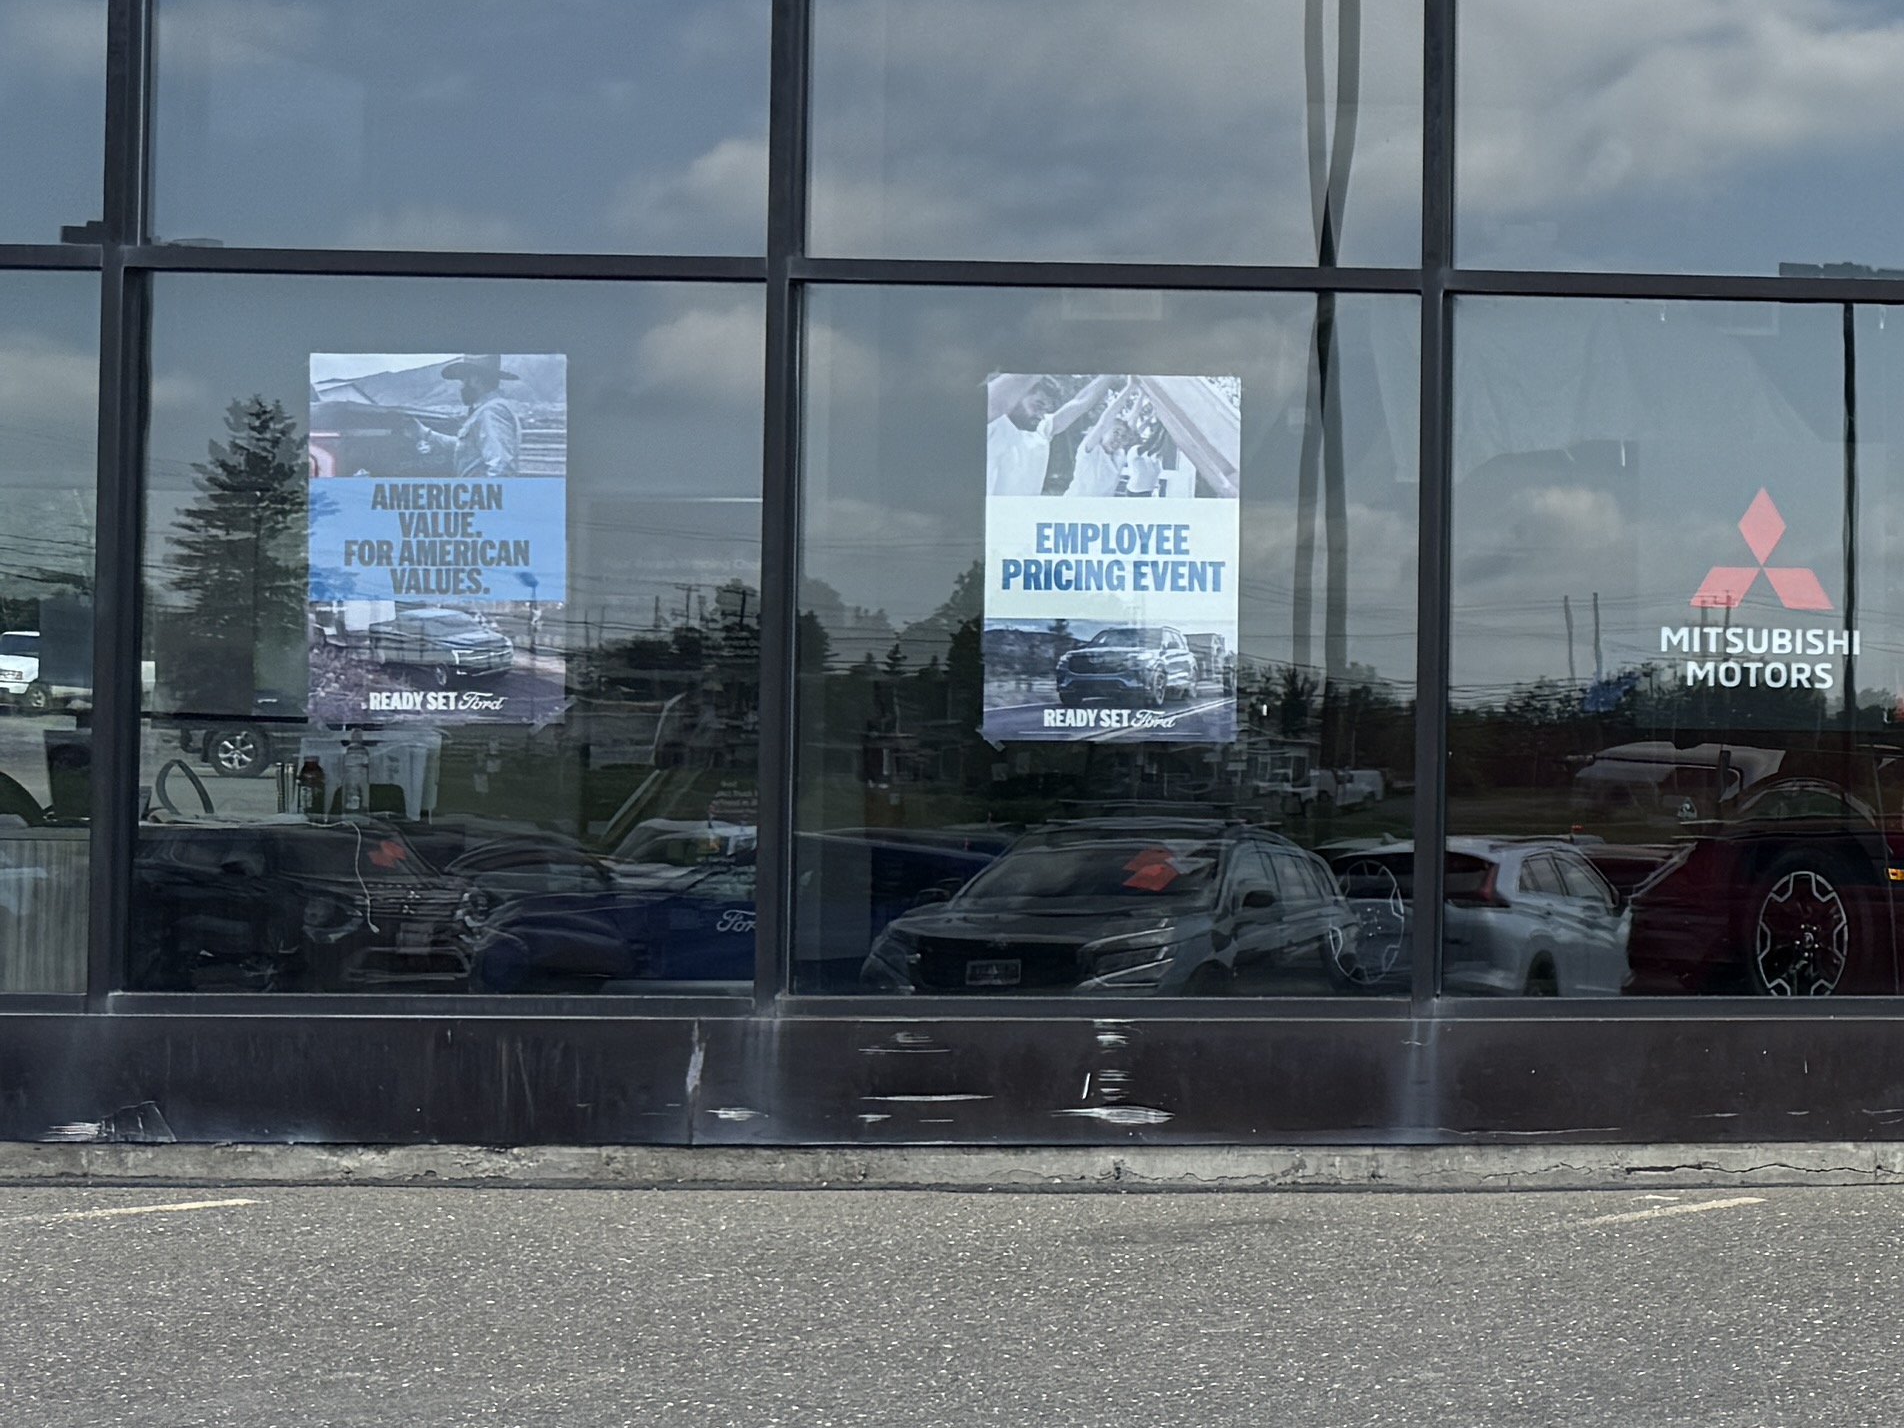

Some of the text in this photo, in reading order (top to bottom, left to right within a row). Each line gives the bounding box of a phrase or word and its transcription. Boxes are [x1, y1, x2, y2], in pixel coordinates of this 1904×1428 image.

[371, 484, 502, 510] AMERICAN
[399, 512, 483, 538] VALUE.
[1036, 523, 1190, 555] EMPLOYEE
[344, 540, 530, 567] FOR AMERICAN
[390, 568, 490, 595] VALUES.
[1001, 559, 1226, 593] PRICING EVENT
[1660, 626, 1861, 656] MITSUBISHI
[1687, 661, 1834, 689] MOTORS
[369, 692, 506, 711] READY SET Ford
[1043, 709, 1177, 729] READY SET Ford
[715, 908, 758, 934] For
